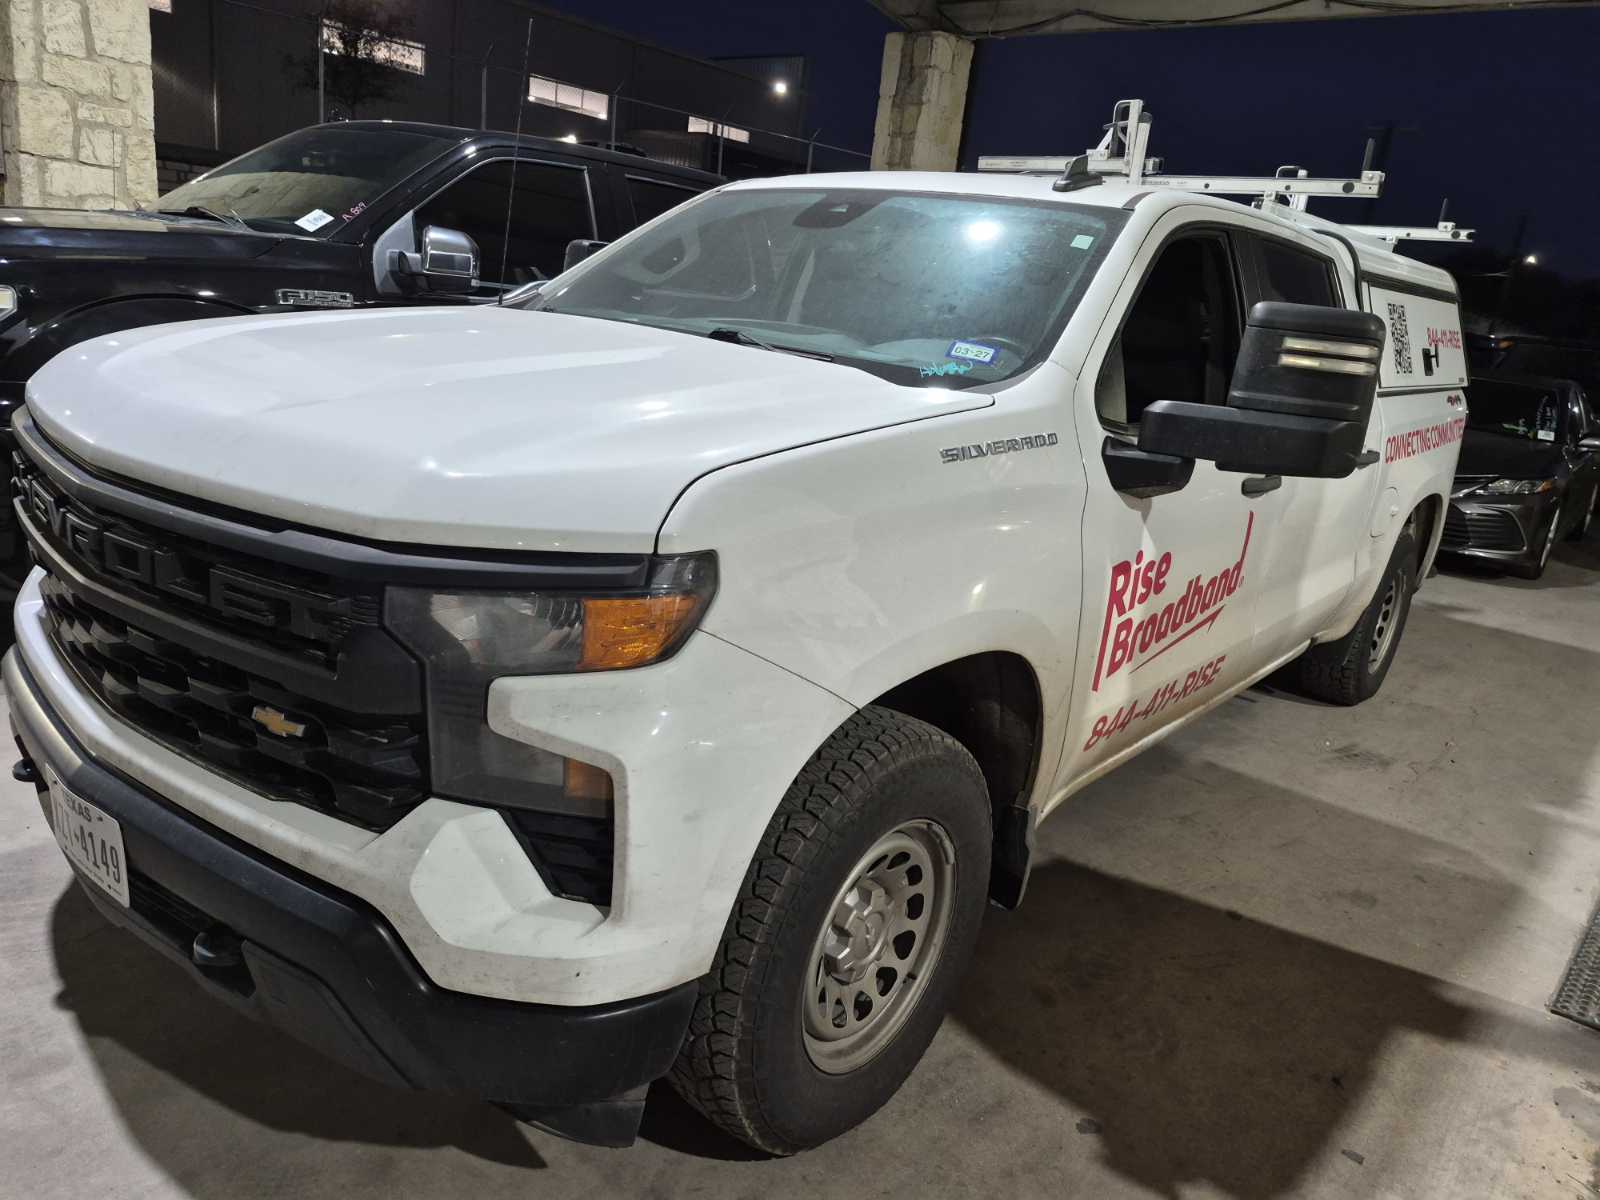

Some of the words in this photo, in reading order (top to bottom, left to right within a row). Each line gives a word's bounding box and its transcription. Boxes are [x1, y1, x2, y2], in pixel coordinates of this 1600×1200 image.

[954, 346, 991, 359] 03-27
[940, 433, 1058, 463] SILVERADO
[1385, 426, 1430, 464] CONNECTING
[1092, 550, 1172, 692] Rise
[1106, 511, 1254, 678] Broadband
[1083, 655, 1226, 752] 844-411-RISE
